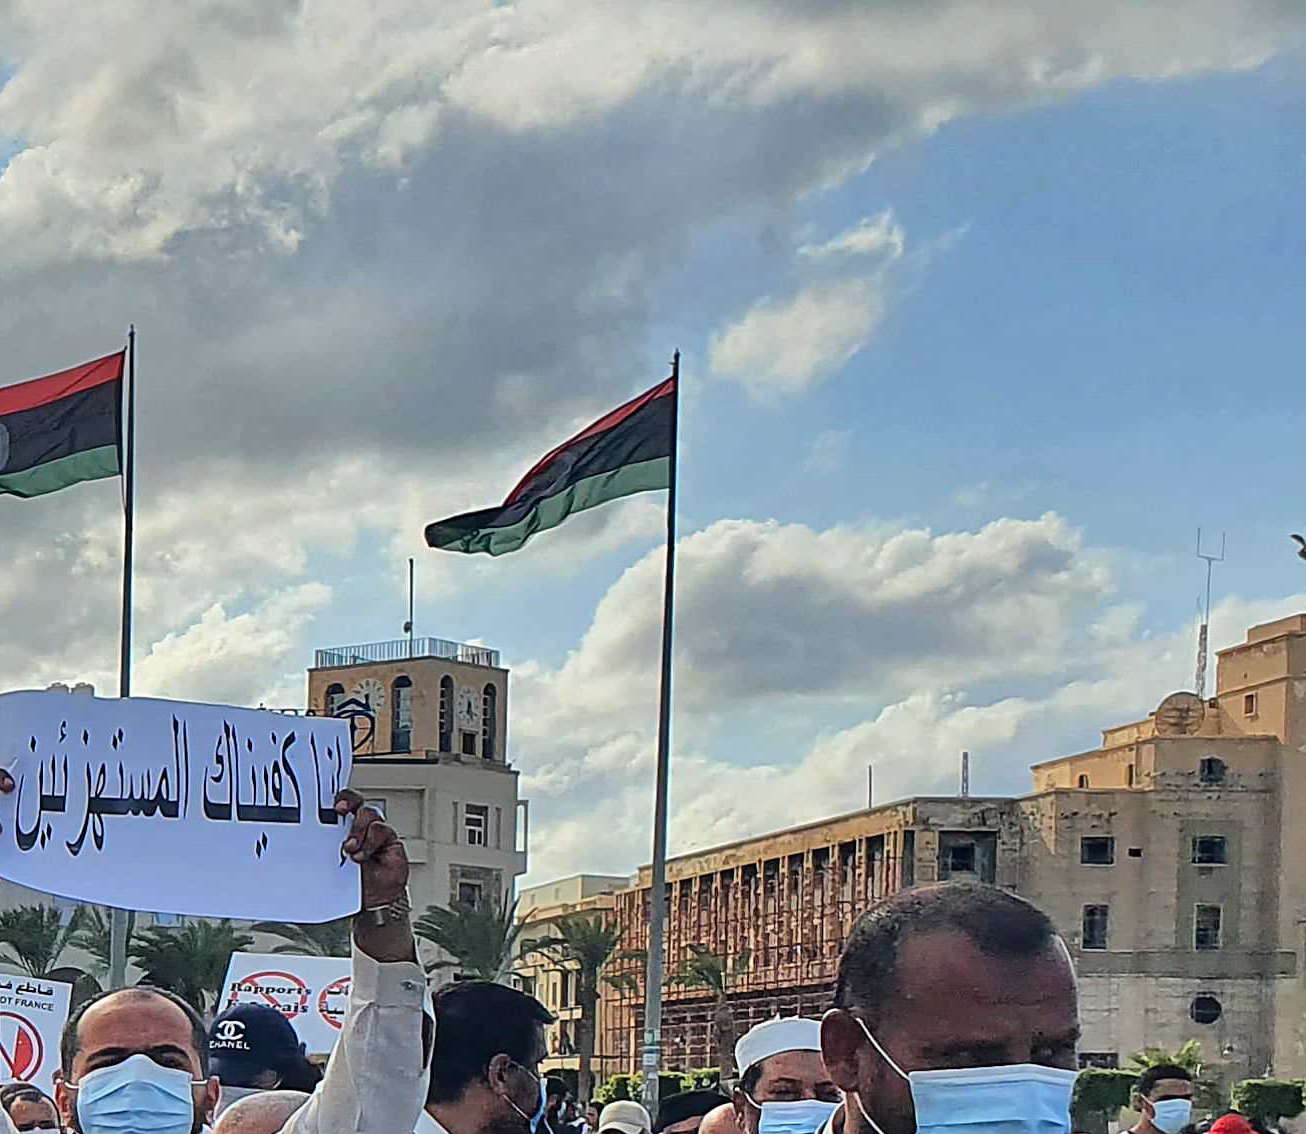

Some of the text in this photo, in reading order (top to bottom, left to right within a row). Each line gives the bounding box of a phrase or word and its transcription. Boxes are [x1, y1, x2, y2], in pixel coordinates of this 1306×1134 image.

[203, 718, 302, 859] كفيناك
[16, 983, 53, 996] قاطع
[230, 983, 312, 995] Rapports
[15, 998, 54, 1011] FRANCE
[209, 1040, 250, 1050] CHANEL
